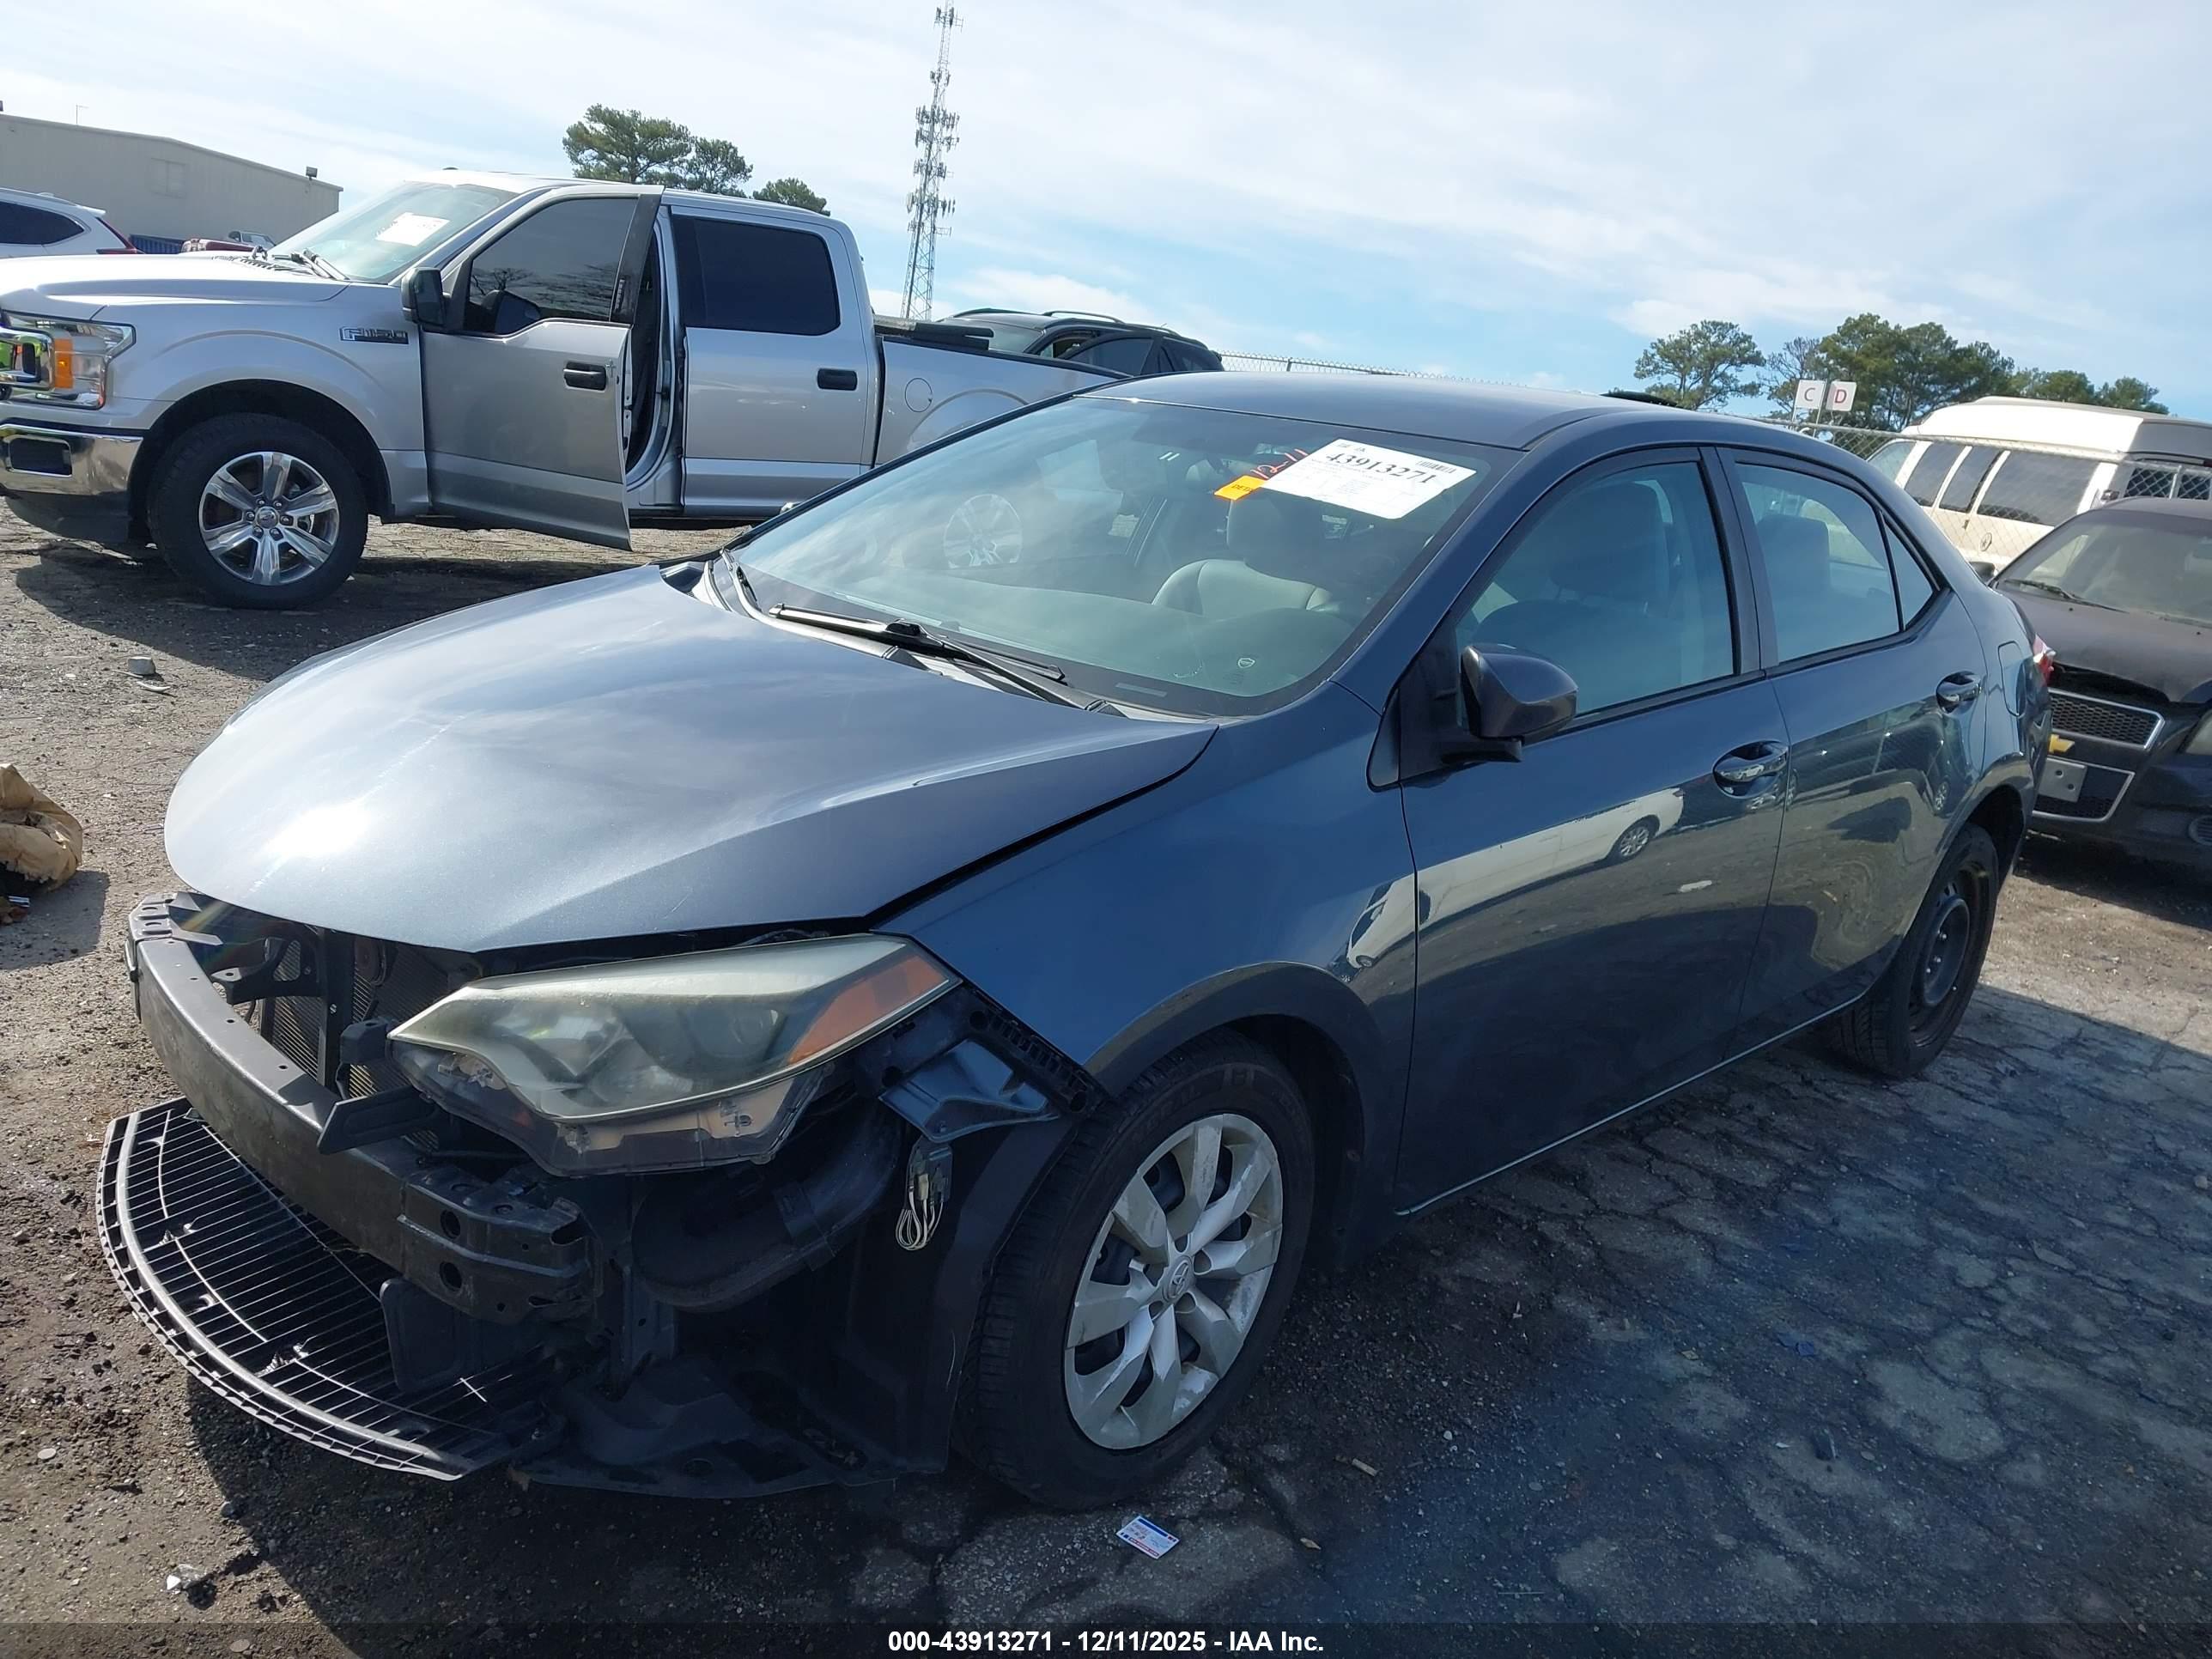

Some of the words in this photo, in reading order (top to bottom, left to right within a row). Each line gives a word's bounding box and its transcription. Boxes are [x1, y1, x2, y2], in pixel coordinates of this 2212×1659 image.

[1804, 387, 1815, 402] C
[1834, 389, 1847, 404] D
[1325, 453, 1436, 483] 43913271
